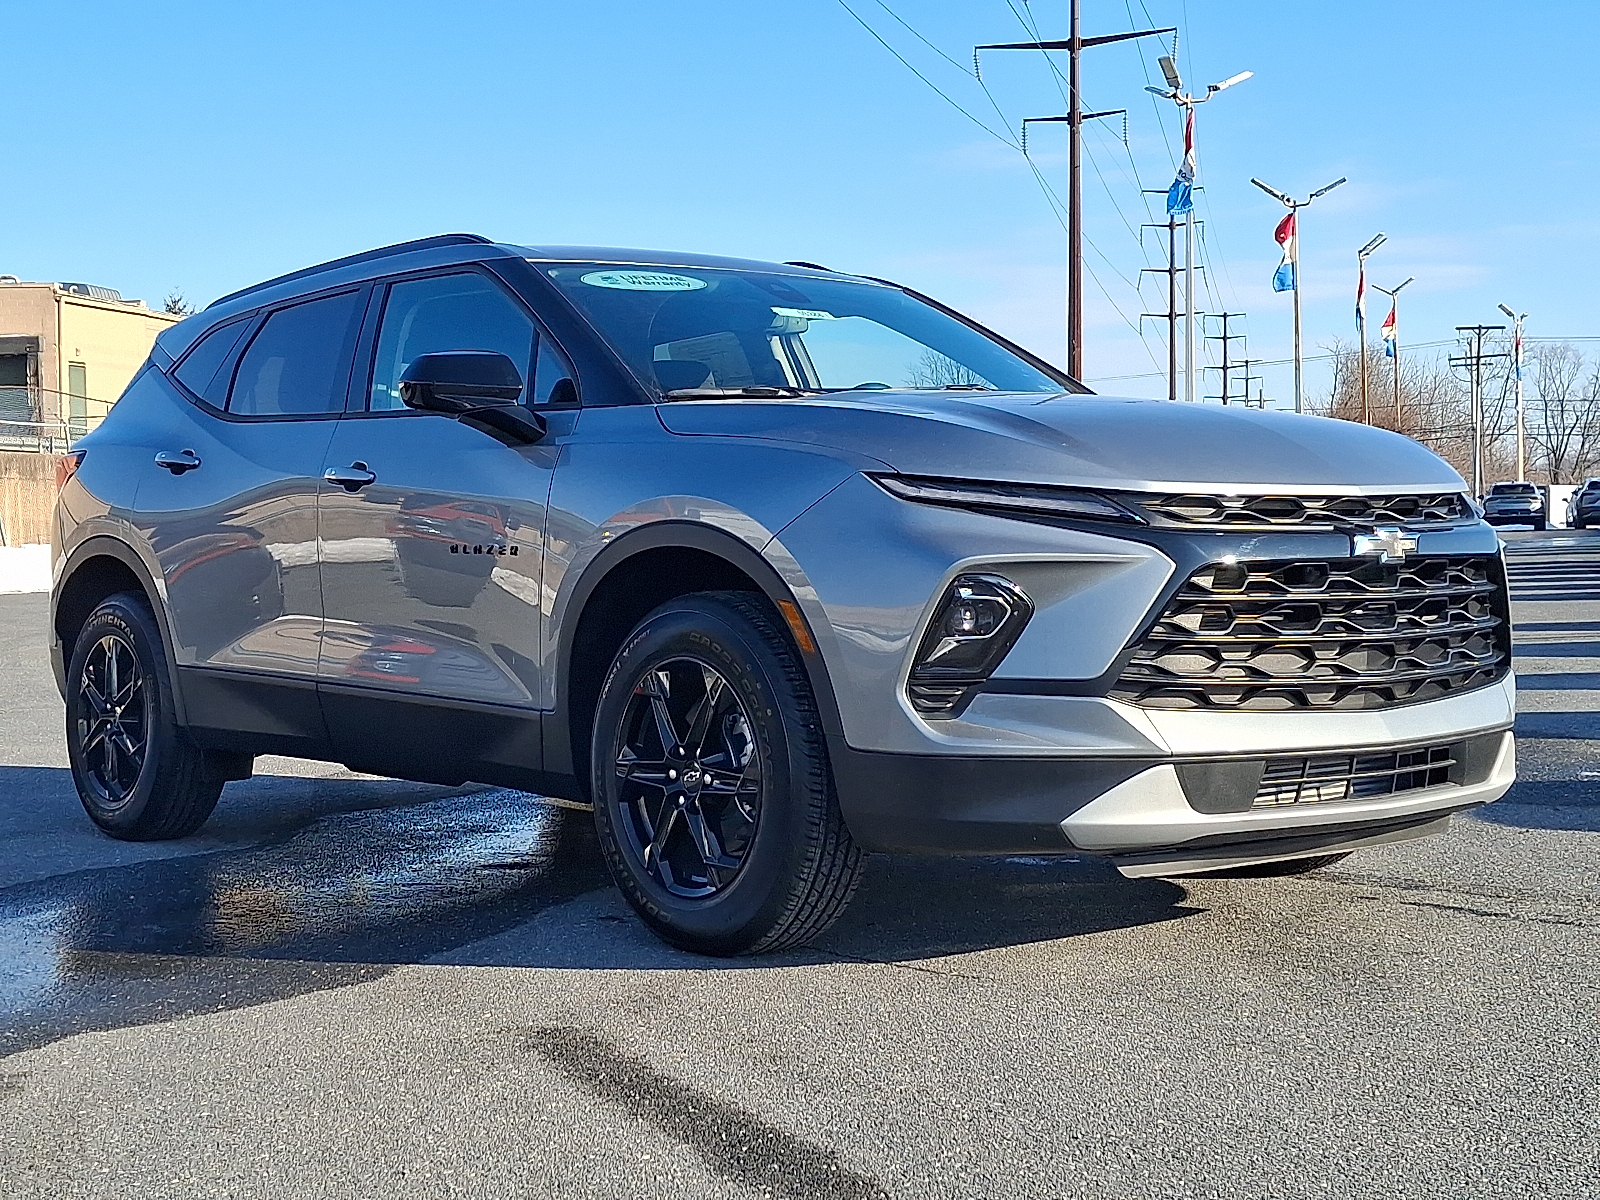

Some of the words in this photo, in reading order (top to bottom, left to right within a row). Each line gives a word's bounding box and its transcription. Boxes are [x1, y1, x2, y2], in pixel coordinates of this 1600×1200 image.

[619, 274, 687, 283] LIFETIME
[627, 278, 691, 288] Warranty
[449, 543, 519, 556] BLAZER
